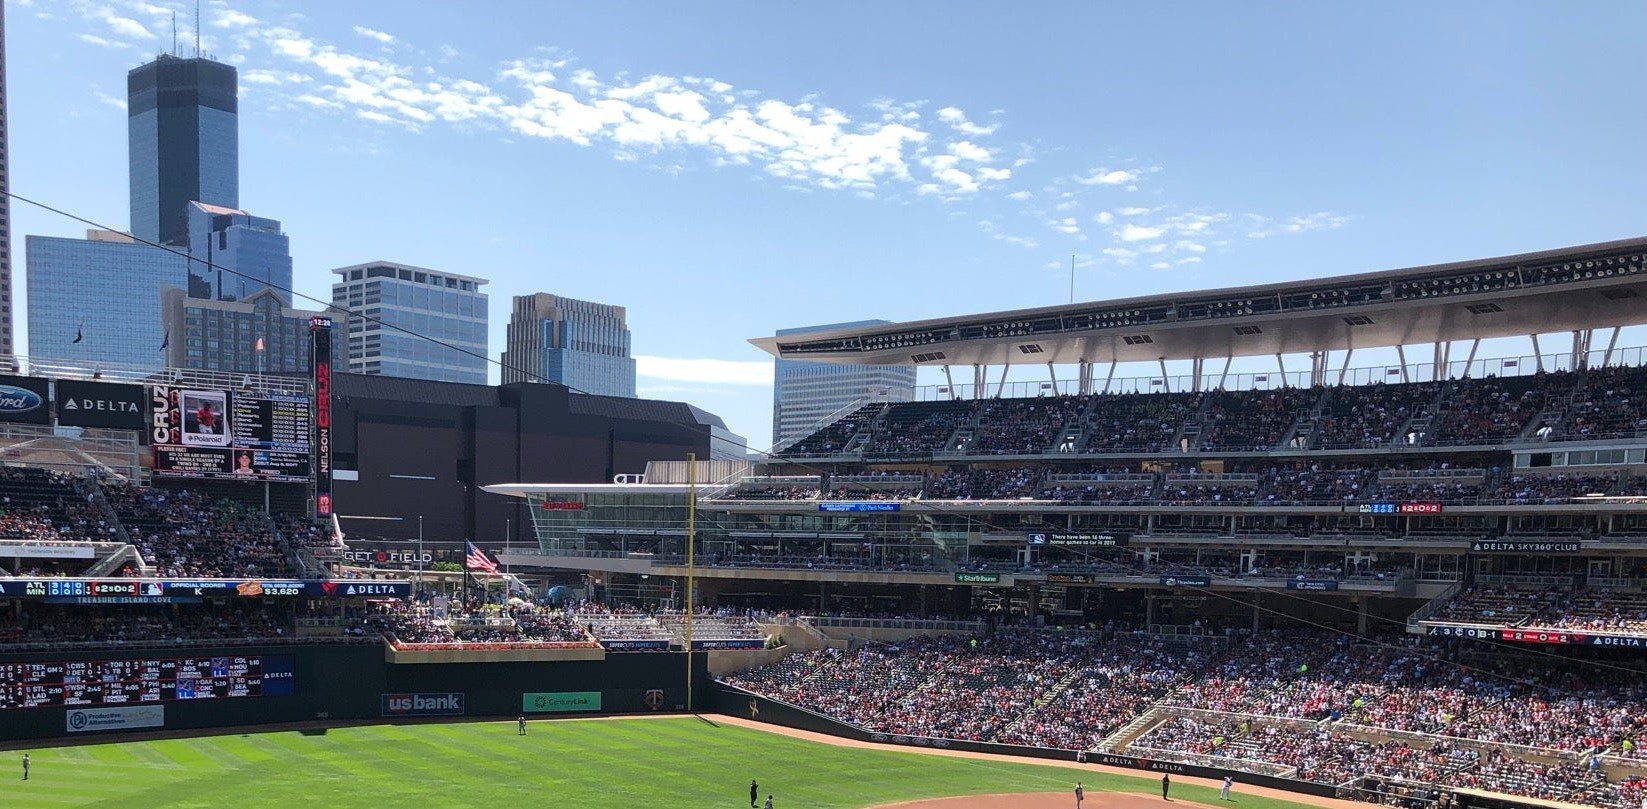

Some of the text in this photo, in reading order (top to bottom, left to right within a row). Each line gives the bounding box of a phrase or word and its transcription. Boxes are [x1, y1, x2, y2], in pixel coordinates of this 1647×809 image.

[317, 363, 330, 428] CRUZ
[84, 400, 138, 412] DELTA
[154, 386, 169, 444] CRUZ
[320, 496, 329, 513] 23
[391, 553, 432, 562] FIELD
[359, 585, 395, 594] DELTA
[1605, 638, 1639, 646] DELTA
[389, 694, 460, 710] usbank
[548, 698, 588, 706] CenturyLink
